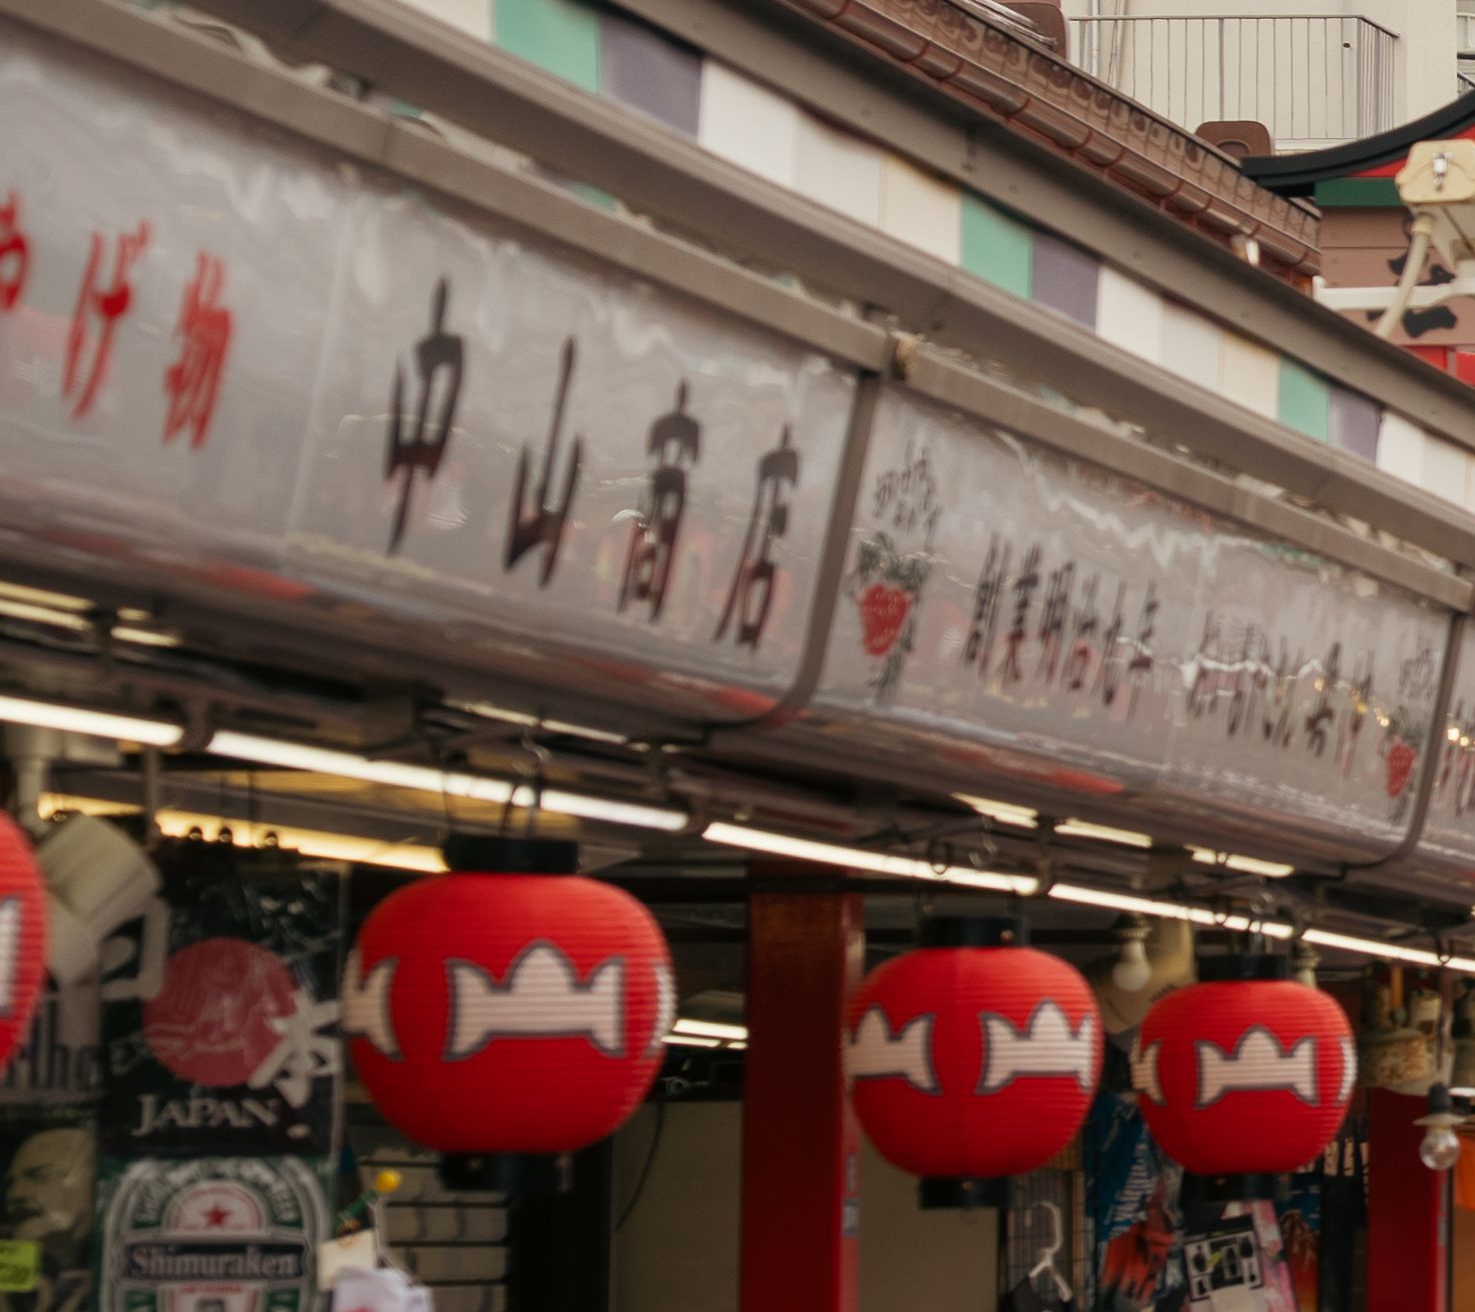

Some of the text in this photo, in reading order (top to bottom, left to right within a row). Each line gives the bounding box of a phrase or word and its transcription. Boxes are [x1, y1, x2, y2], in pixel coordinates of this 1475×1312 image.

[384, 273, 800, 653] 中山商店
[131, 1093, 281, 1137] JAPAN
[129, 1242, 298, 1277] Shimuraken
